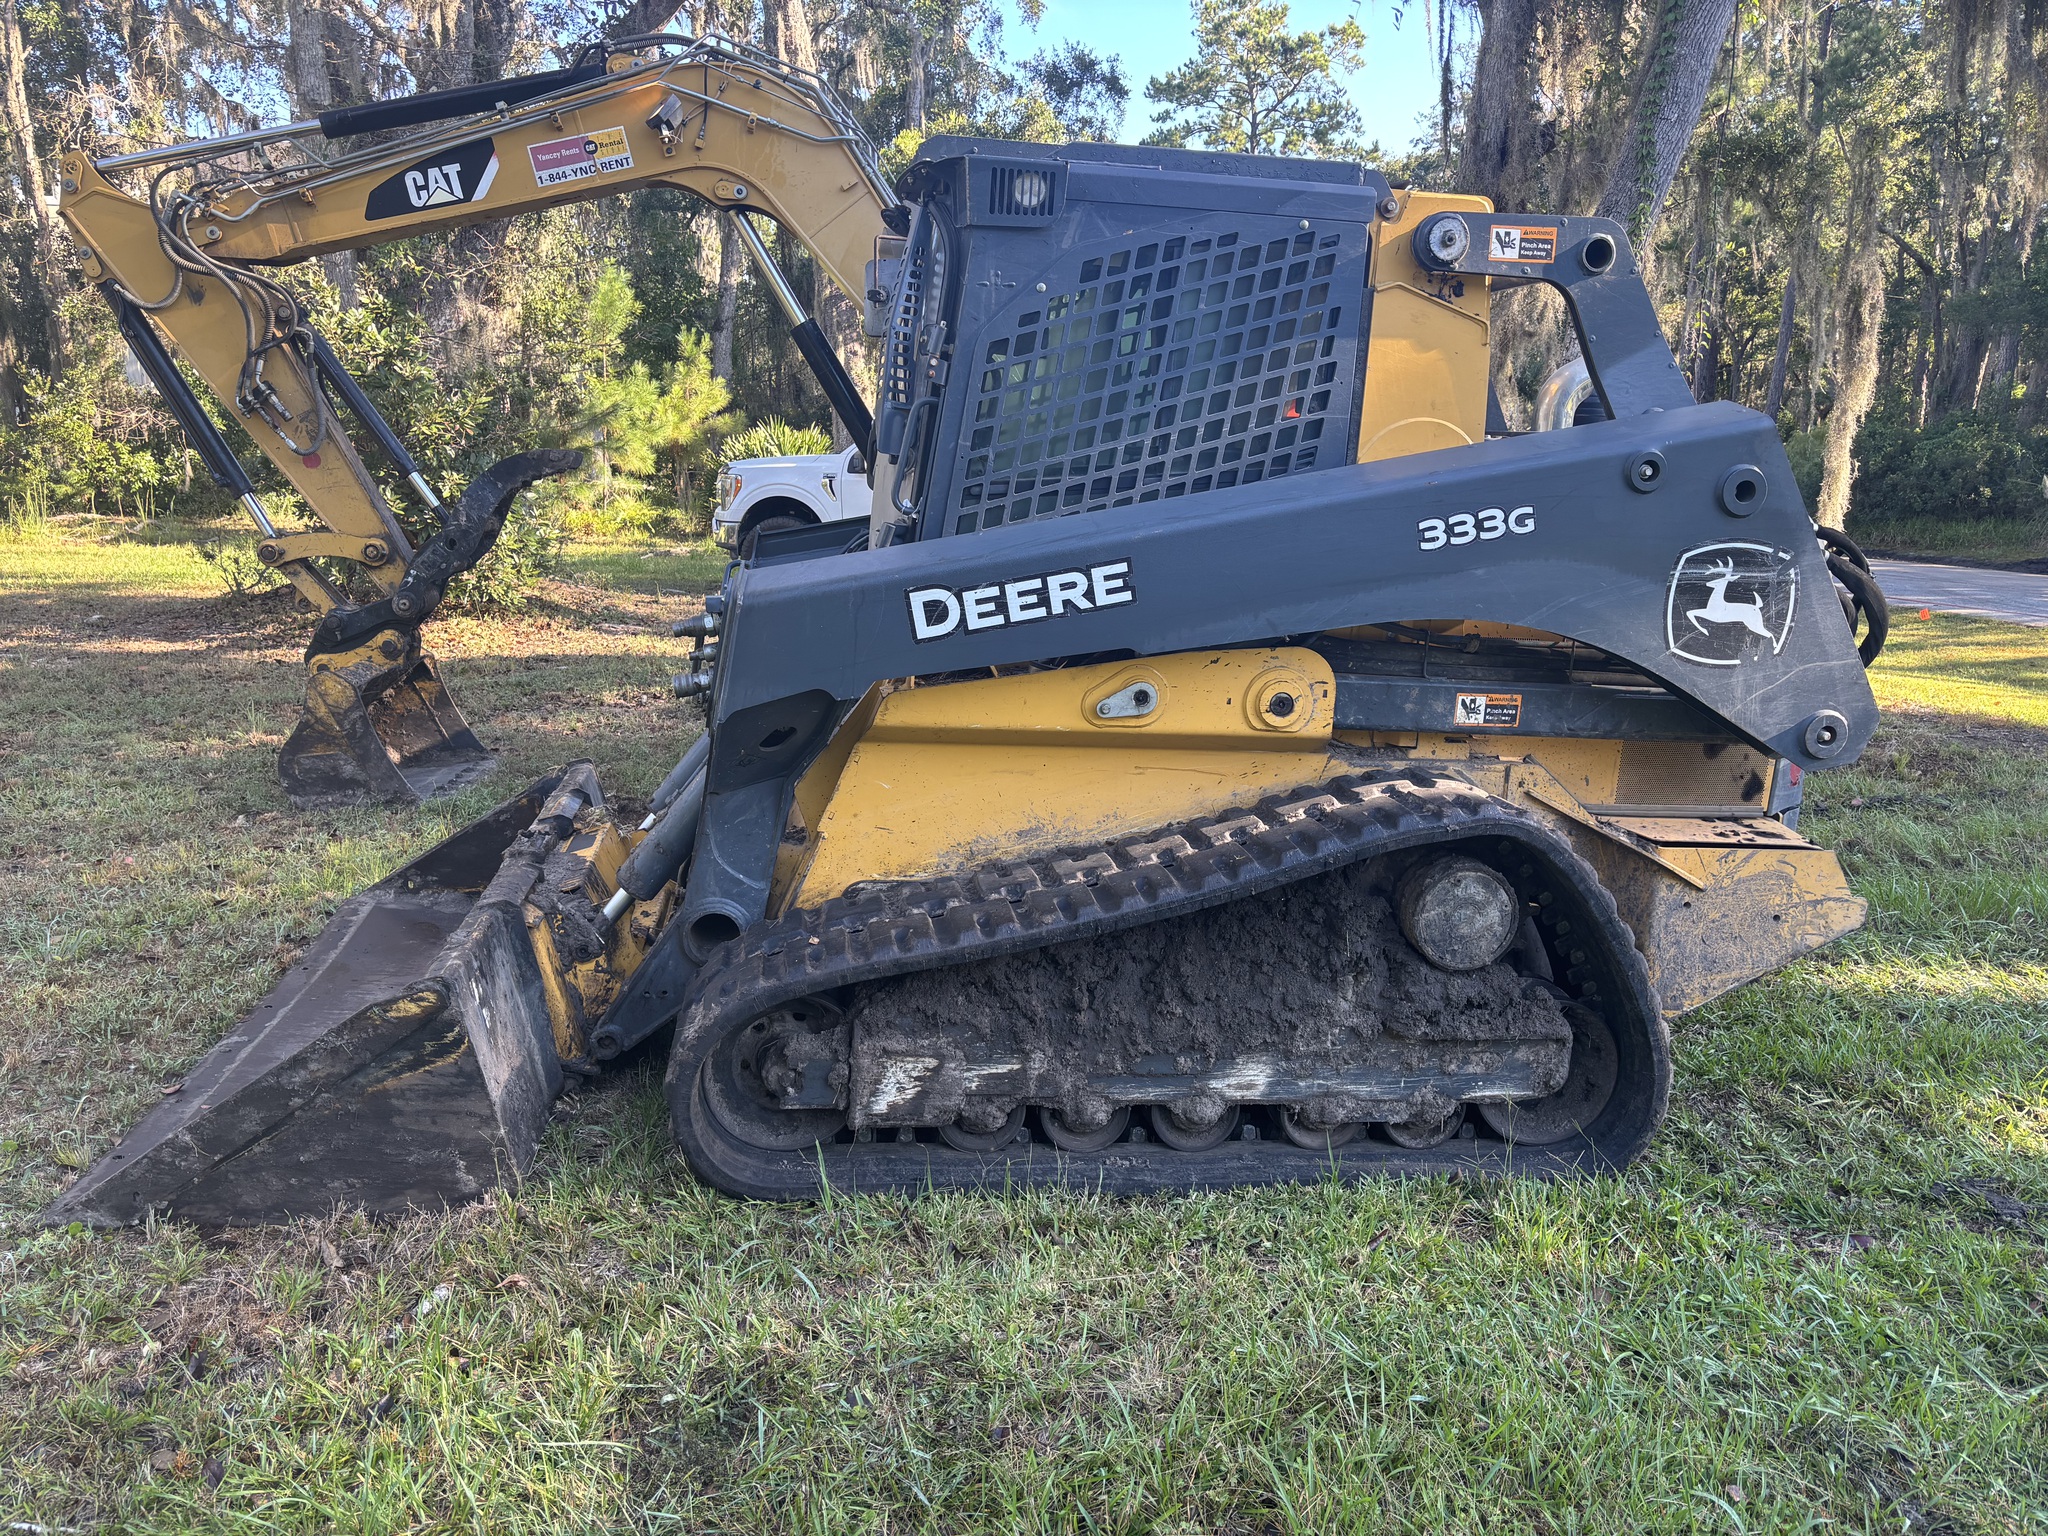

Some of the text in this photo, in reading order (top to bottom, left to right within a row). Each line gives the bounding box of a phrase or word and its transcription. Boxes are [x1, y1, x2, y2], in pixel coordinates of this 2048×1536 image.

[537, 147, 580, 162] Yancey Rents
[585, 143, 596, 152] CAT
[599, 138, 624, 149] Rental
[404, 163, 464, 208] CAT
[1521, 241, 1537, 249] Pinch
[1418, 506, 1536, 550] 333G
[908, 562, 1133, 640] DEERE
